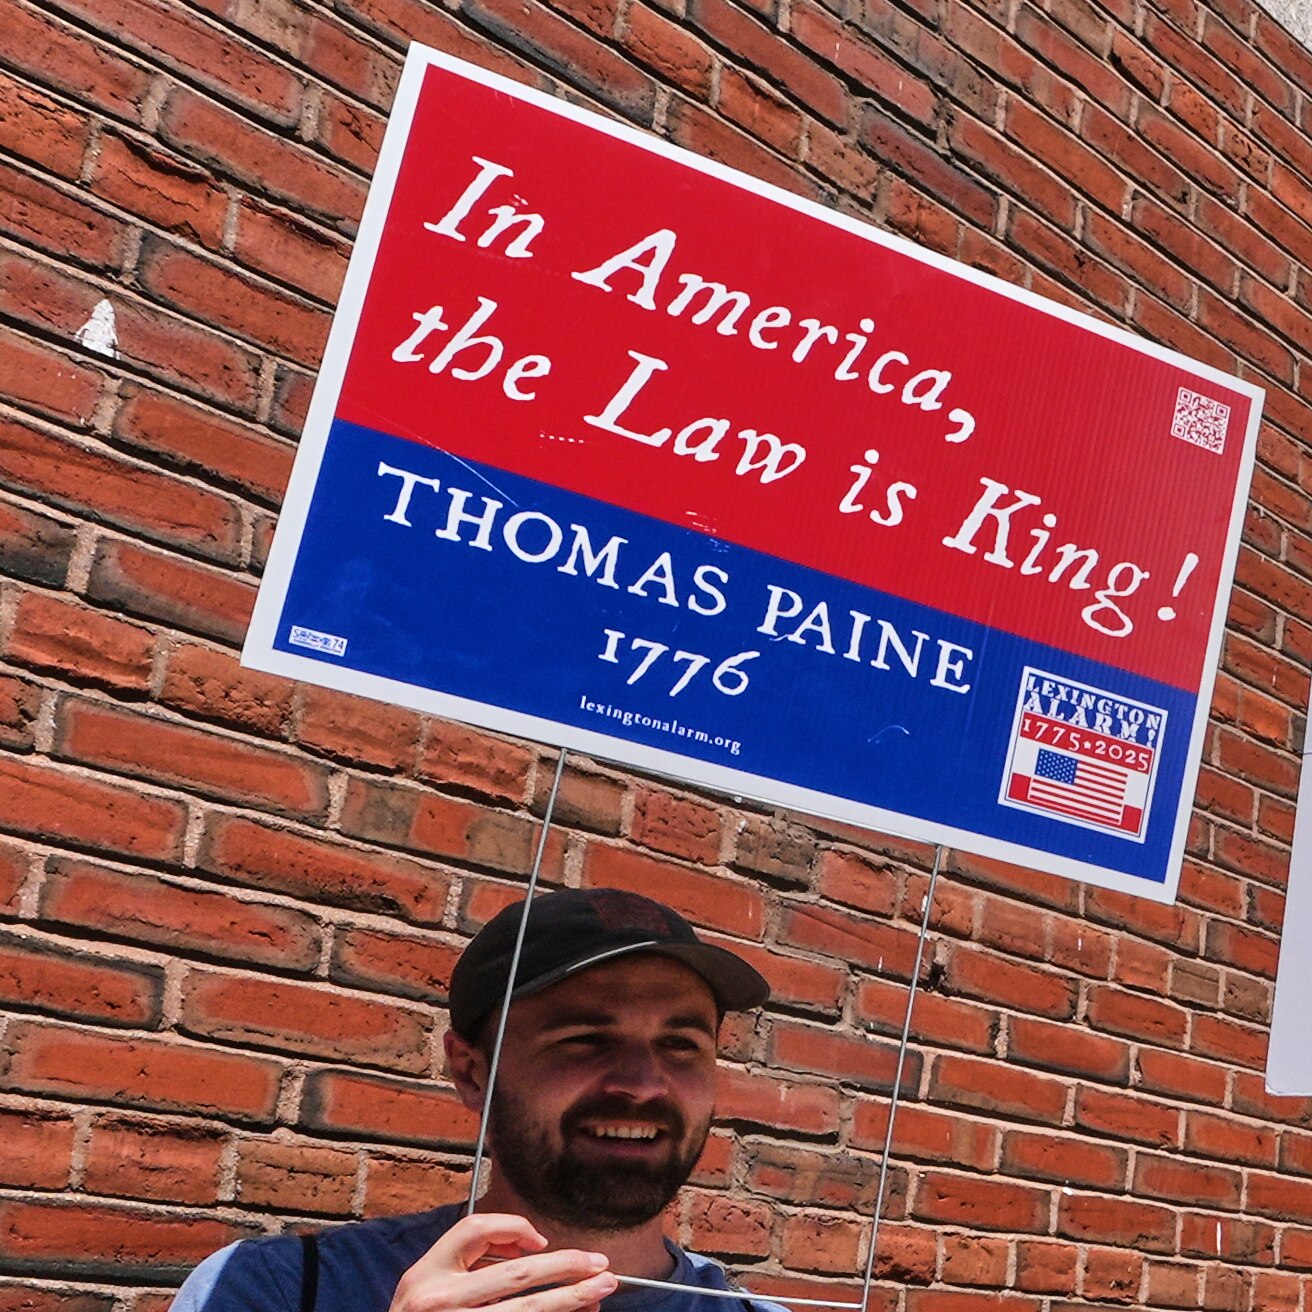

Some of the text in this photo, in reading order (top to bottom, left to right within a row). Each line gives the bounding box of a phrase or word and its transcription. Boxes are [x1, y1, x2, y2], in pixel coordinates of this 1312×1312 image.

[422, 155, 976, 444] In America,
[391, 296, 1199, 638] the Law is King!
[377, 461, 974, 695] THOMAS PAINE
[598, 628, 762, 697] 1776
[579, 695, 743, 756] lexingtonalarm.org
[1023, 691, 1157, 748] ALARM!
[1026, 676, 1161, 730] LEXINGTON
[1022, 718, 1150, 771] 1775 2025
